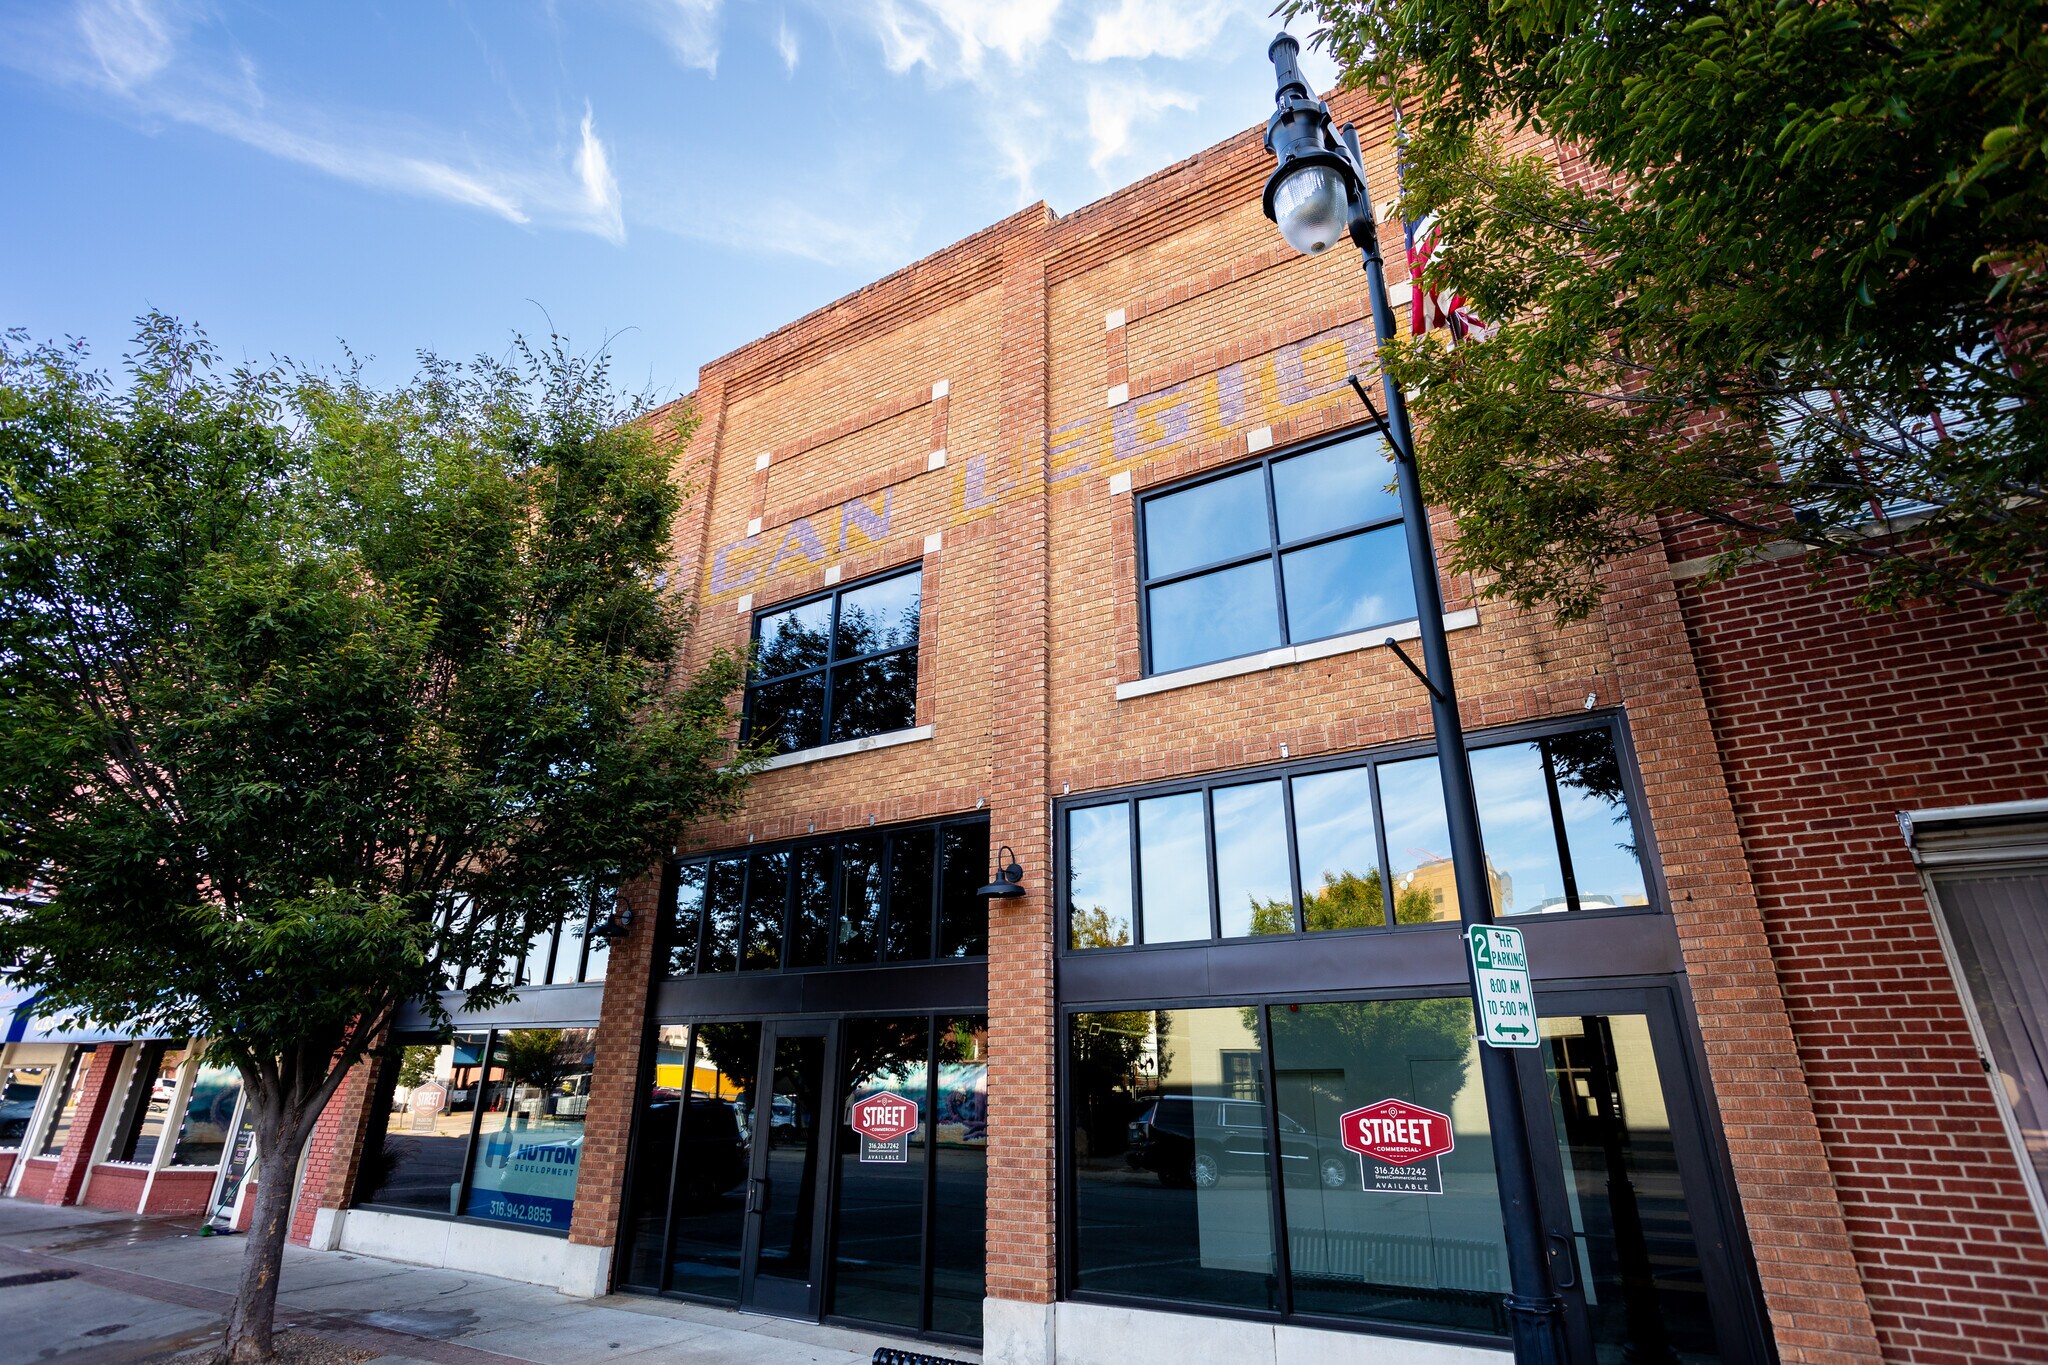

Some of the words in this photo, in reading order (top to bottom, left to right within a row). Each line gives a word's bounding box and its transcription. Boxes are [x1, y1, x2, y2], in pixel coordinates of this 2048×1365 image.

[1474, 933, 1490, 963] 2
[1499, 934, 1513, 949] HR
[1491, 950, 1524, 967] PARKING
[1490, 978, 1507, 994] 8:00
[1510, 979, 1521, 994] AM
[1487, 1000, 1498, 1015] TO
[1500, 1001, 1517, 1016] 5:00
[1519, 1002, 1530, 1017] PM
[862, 1106, 907, 1128] STREET
[1359, 1118, 1432, 1147] STREET
[516, 1144, 577, 1165] HUTTON
[514, 1163, 574, 1176] DEVELOPMENT
[1374, 1166, 1427, 1176] 316.263.7242
[1375, 1182, 1429, 1191] AVAILABLE
[489, 1200, 552, 1223] 316.942.8855
